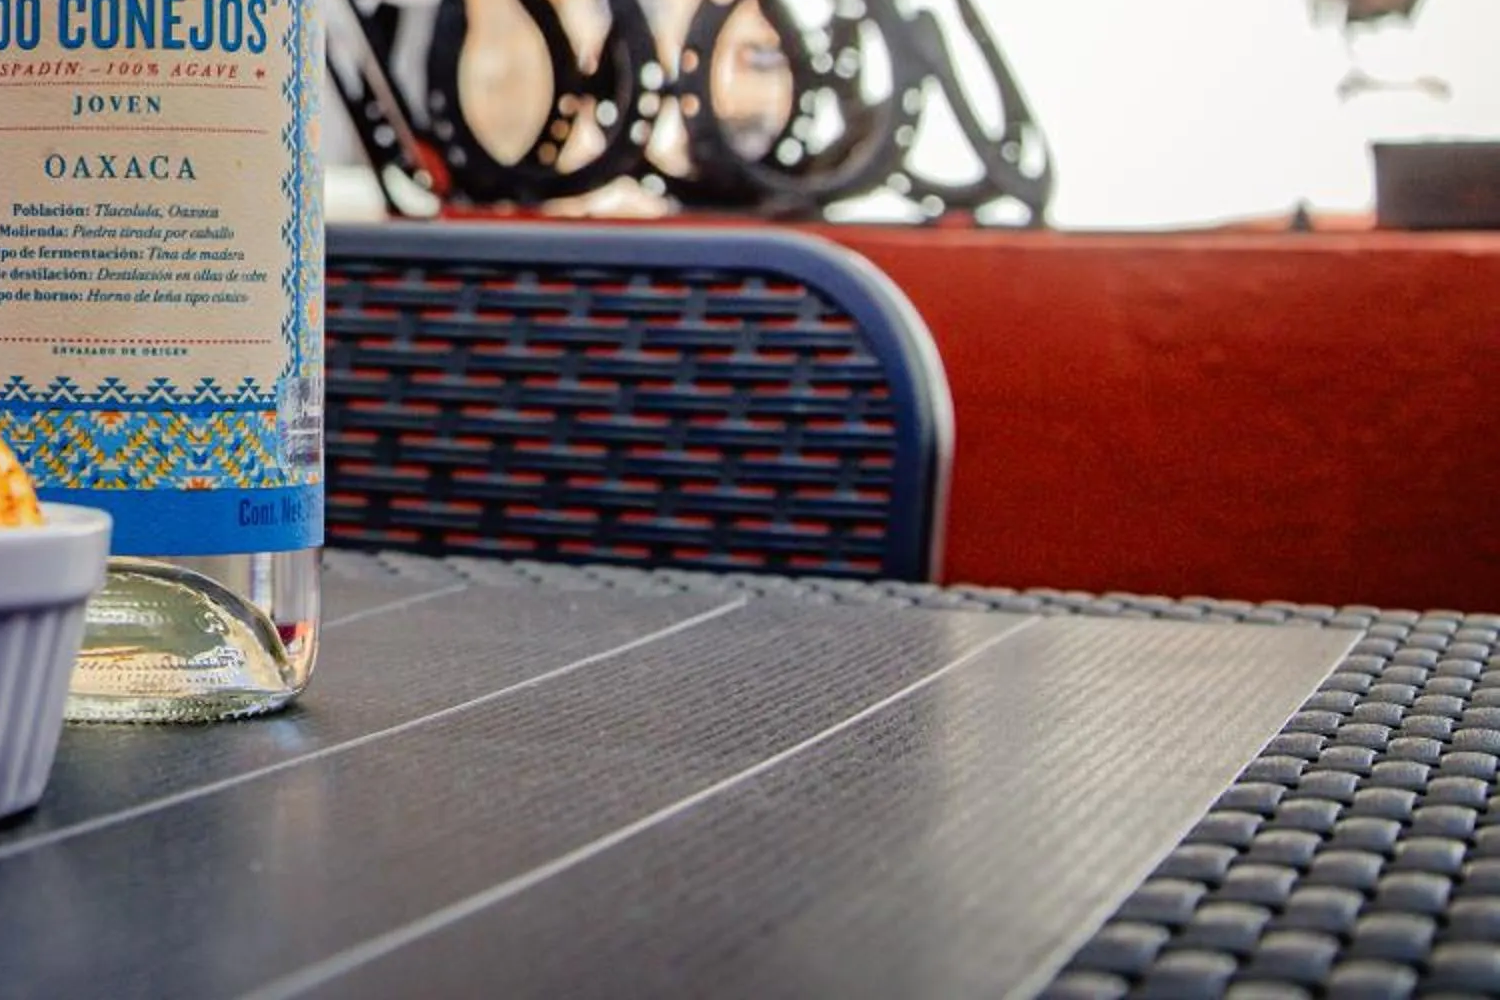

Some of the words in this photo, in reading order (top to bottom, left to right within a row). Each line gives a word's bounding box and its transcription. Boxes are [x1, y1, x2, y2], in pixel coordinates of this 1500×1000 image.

[170, 63, 241, 79] AGAVE
[73, 94, 162, 116] JOVEN
[44, 153, 197, 181] OAXACA
[12, 203, 90, 217] Población:
[168, 204, 219, 218] Oaxaca
[0, 224, 68, 237] Molienda:
[163, 228, 189, 242] por
[190, 226, 235, 239] caballo
[19, 246, 36, 259] de
[38, 245, 144, 261] fermentación:
[181, 248, 197, 260] de
[199, 248, 245, 260] madera
[9, 266, 93, 281] destilación:
[175, 271, 191, 282] en
[225, 268, 239, 282] de
[14, 288, 31, 301] de
[33, 287, 83, 302] horno:
[86, 288, 132, 303] Horno
[133, 289, 151, 302] de
[120, 346, 137, 357] DE
